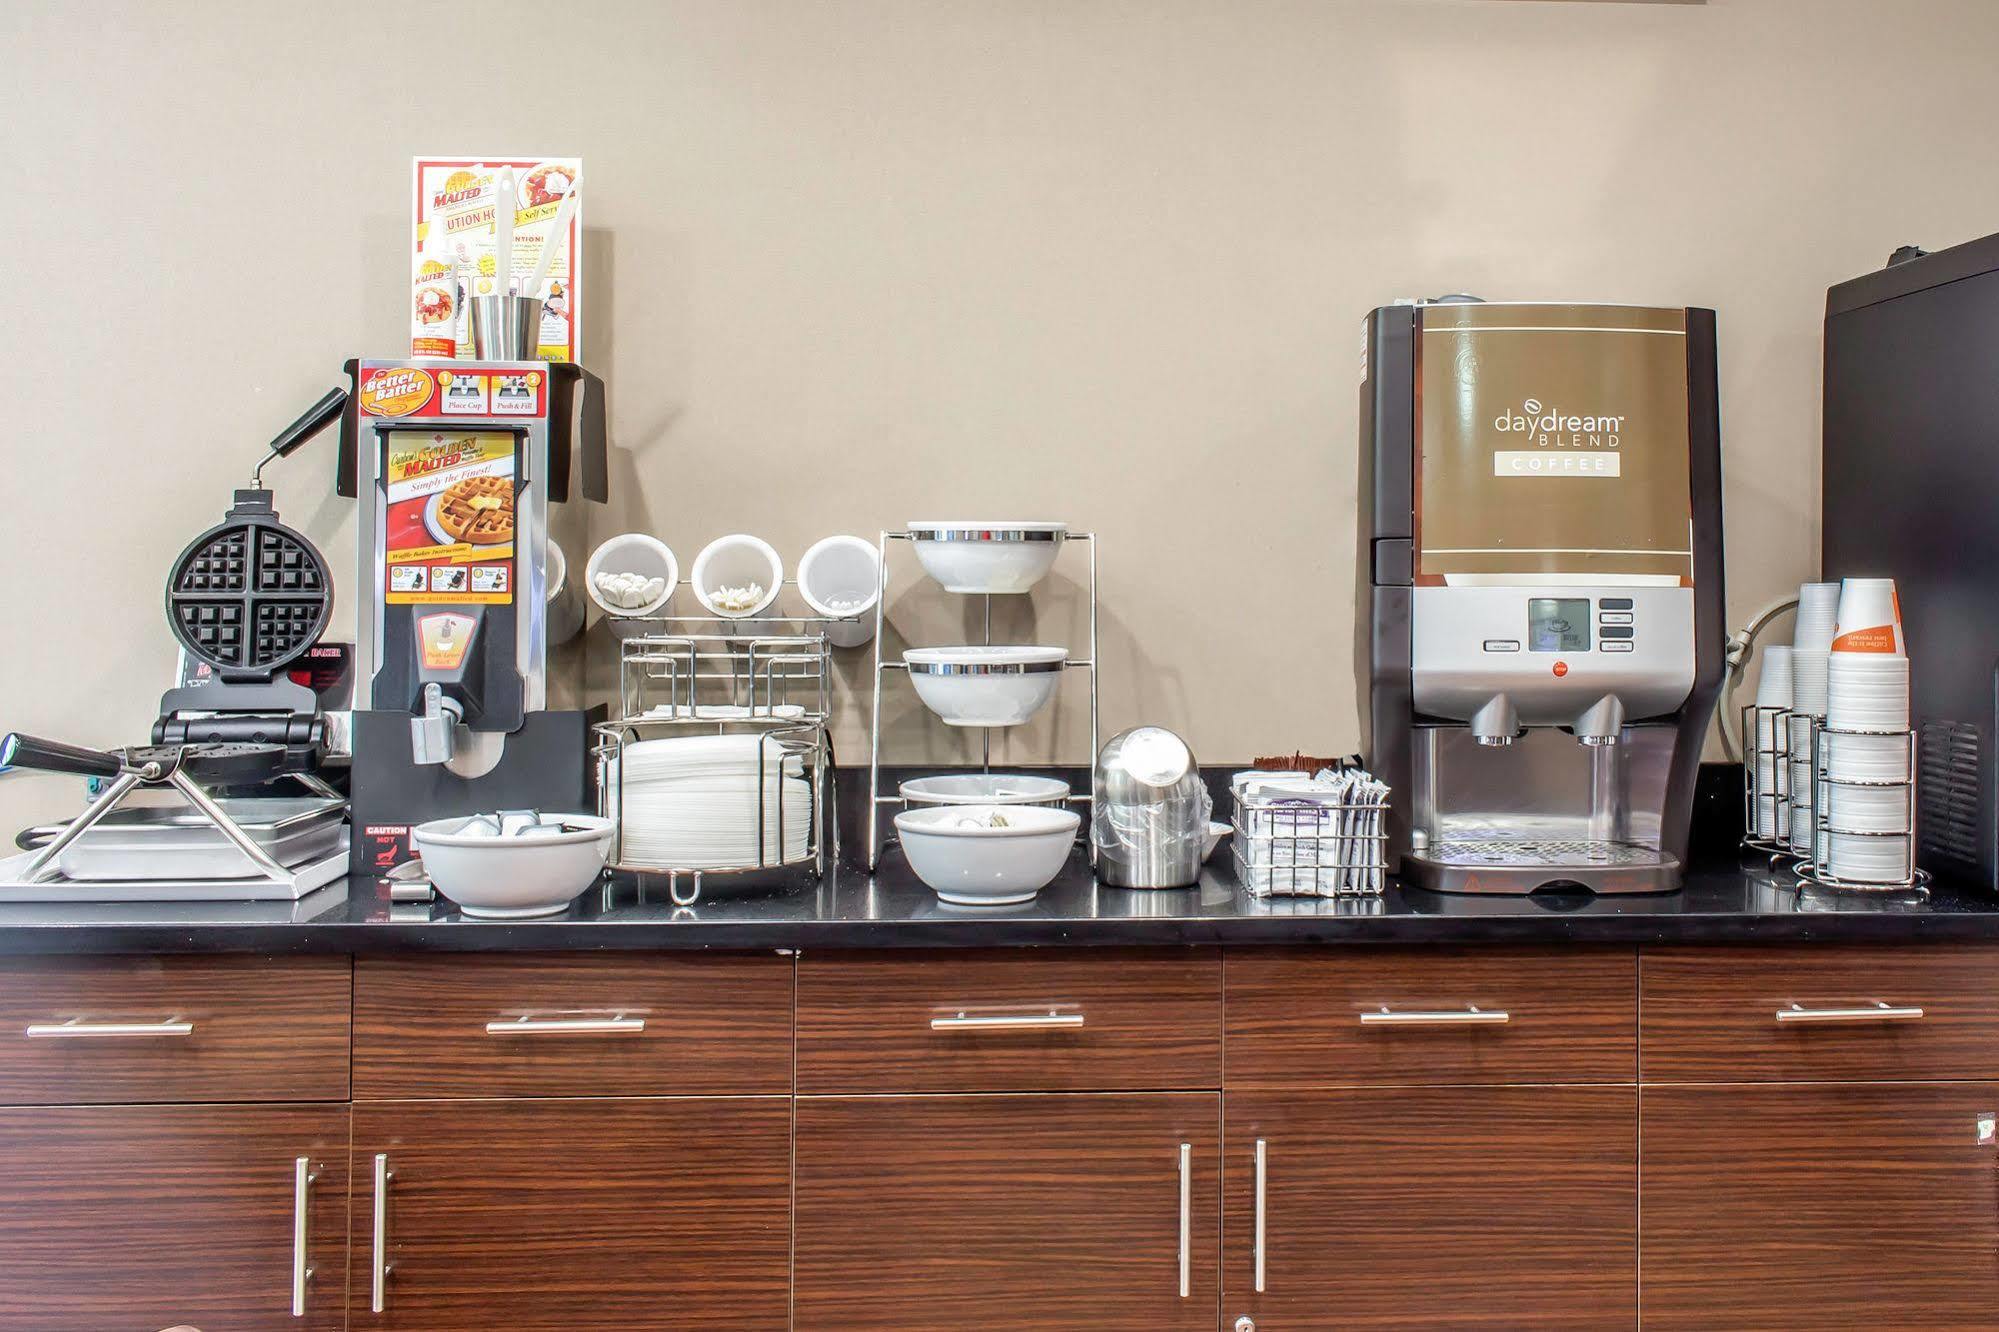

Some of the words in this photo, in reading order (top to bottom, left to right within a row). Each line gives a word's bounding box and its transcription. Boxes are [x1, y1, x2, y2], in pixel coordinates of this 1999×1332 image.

[433, 187, 482, 208] MALTED
[447, 213, 481, 230] UTION
[366, 372, 416, 393] Better
[375, 380, 424, 402] Batter
[467, 402, 482, 410] Cup
[496, 402, 513, 410] Push
[1494, 408, 1619, 441] daydream
[1539, 434, 1619, 447] BLEND
[403, 452, 462, 477] MALTED
[1511, 458, 1605, 470] COFFEE
[410, 477, 441, 492] Simply
[444, 473, 460, 484] the
[461, 464, 492, 479] Finest!
[310, 647, 342, 658] BAKER
[367, 826, 407, 835] CAUTION
